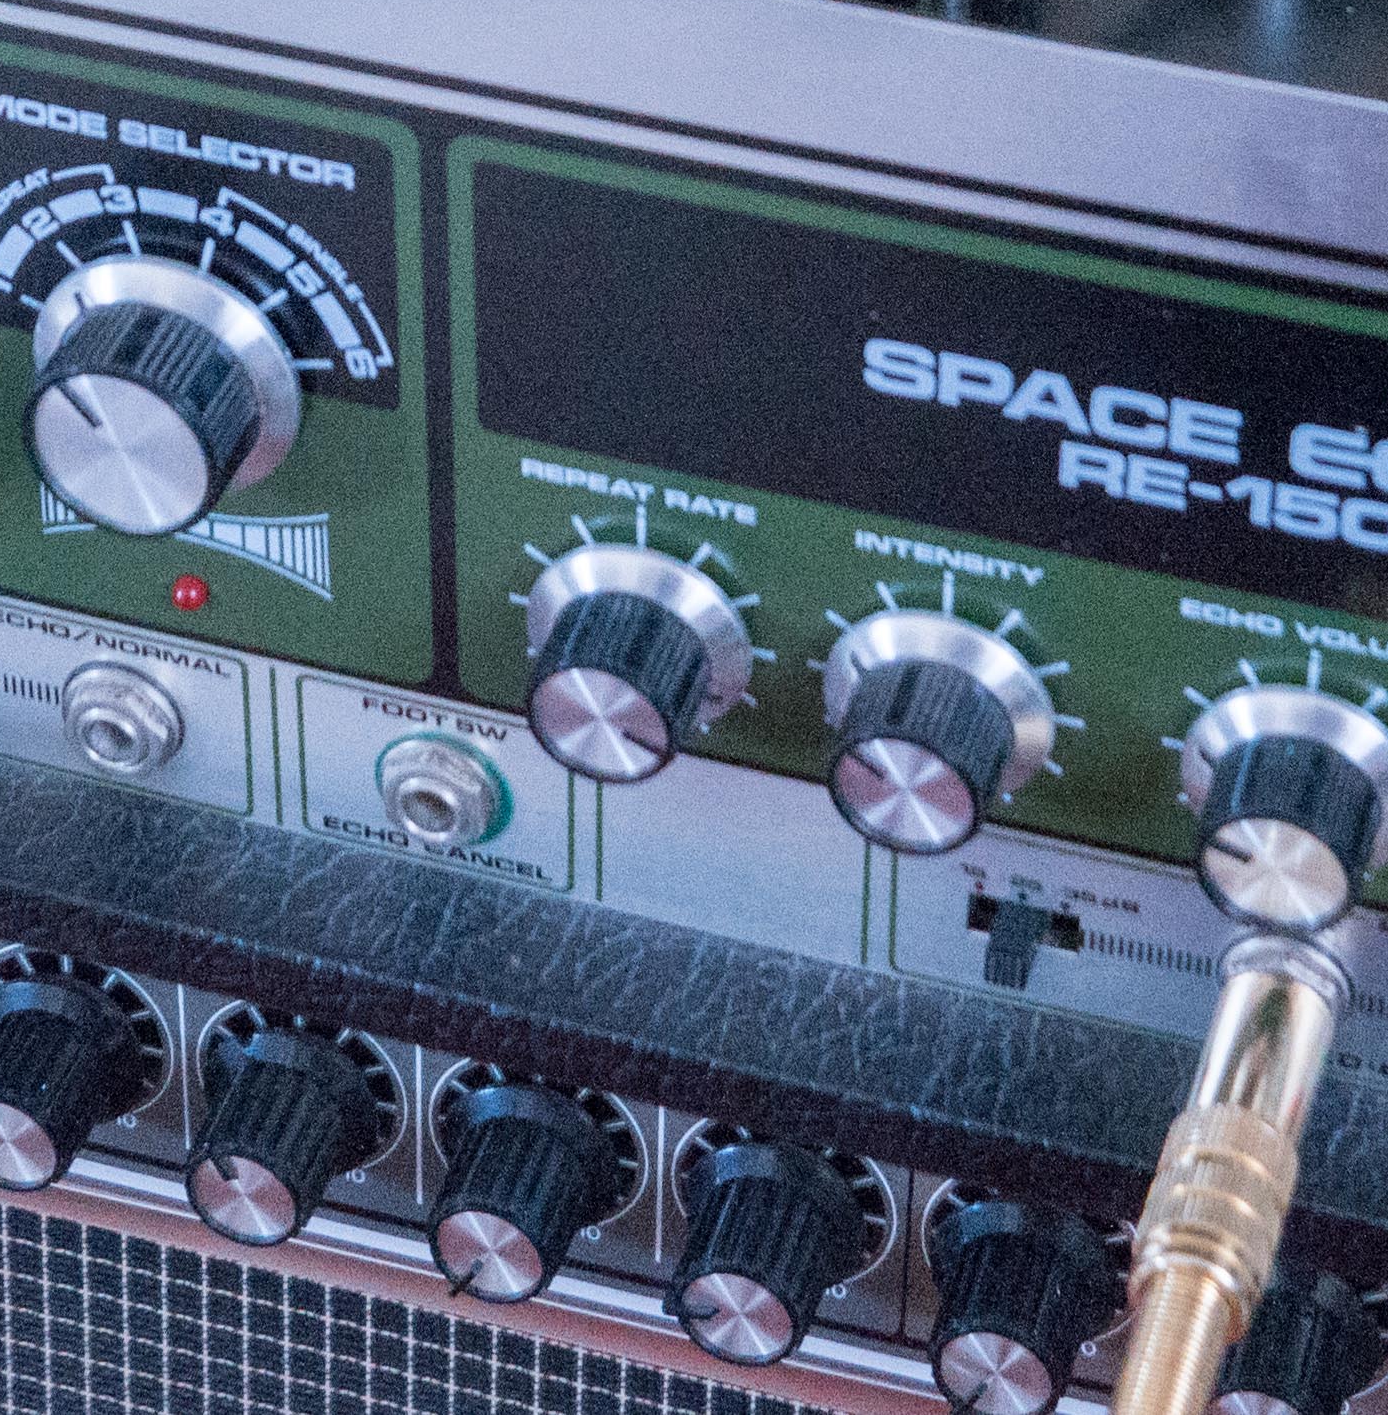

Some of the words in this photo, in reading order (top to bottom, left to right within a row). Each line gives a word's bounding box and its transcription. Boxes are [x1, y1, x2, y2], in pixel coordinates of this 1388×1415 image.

[117, 118, 356, 192] SELECTOR
[860, 336, 1244, 466] SPACE
[519, 457, 656, 505] REPEAT
[664, 486, 760, 527] RATE
[853, 529, 1046, 588] INTENSITY
[1178, 597, 1285, 639] ECHO
[361, 695, 450, 729] FOOT
[455, 715, 510, 744] SW
[322, 813, 410, 850] ECHO
[418, 840, 553, 883] CANCEL
